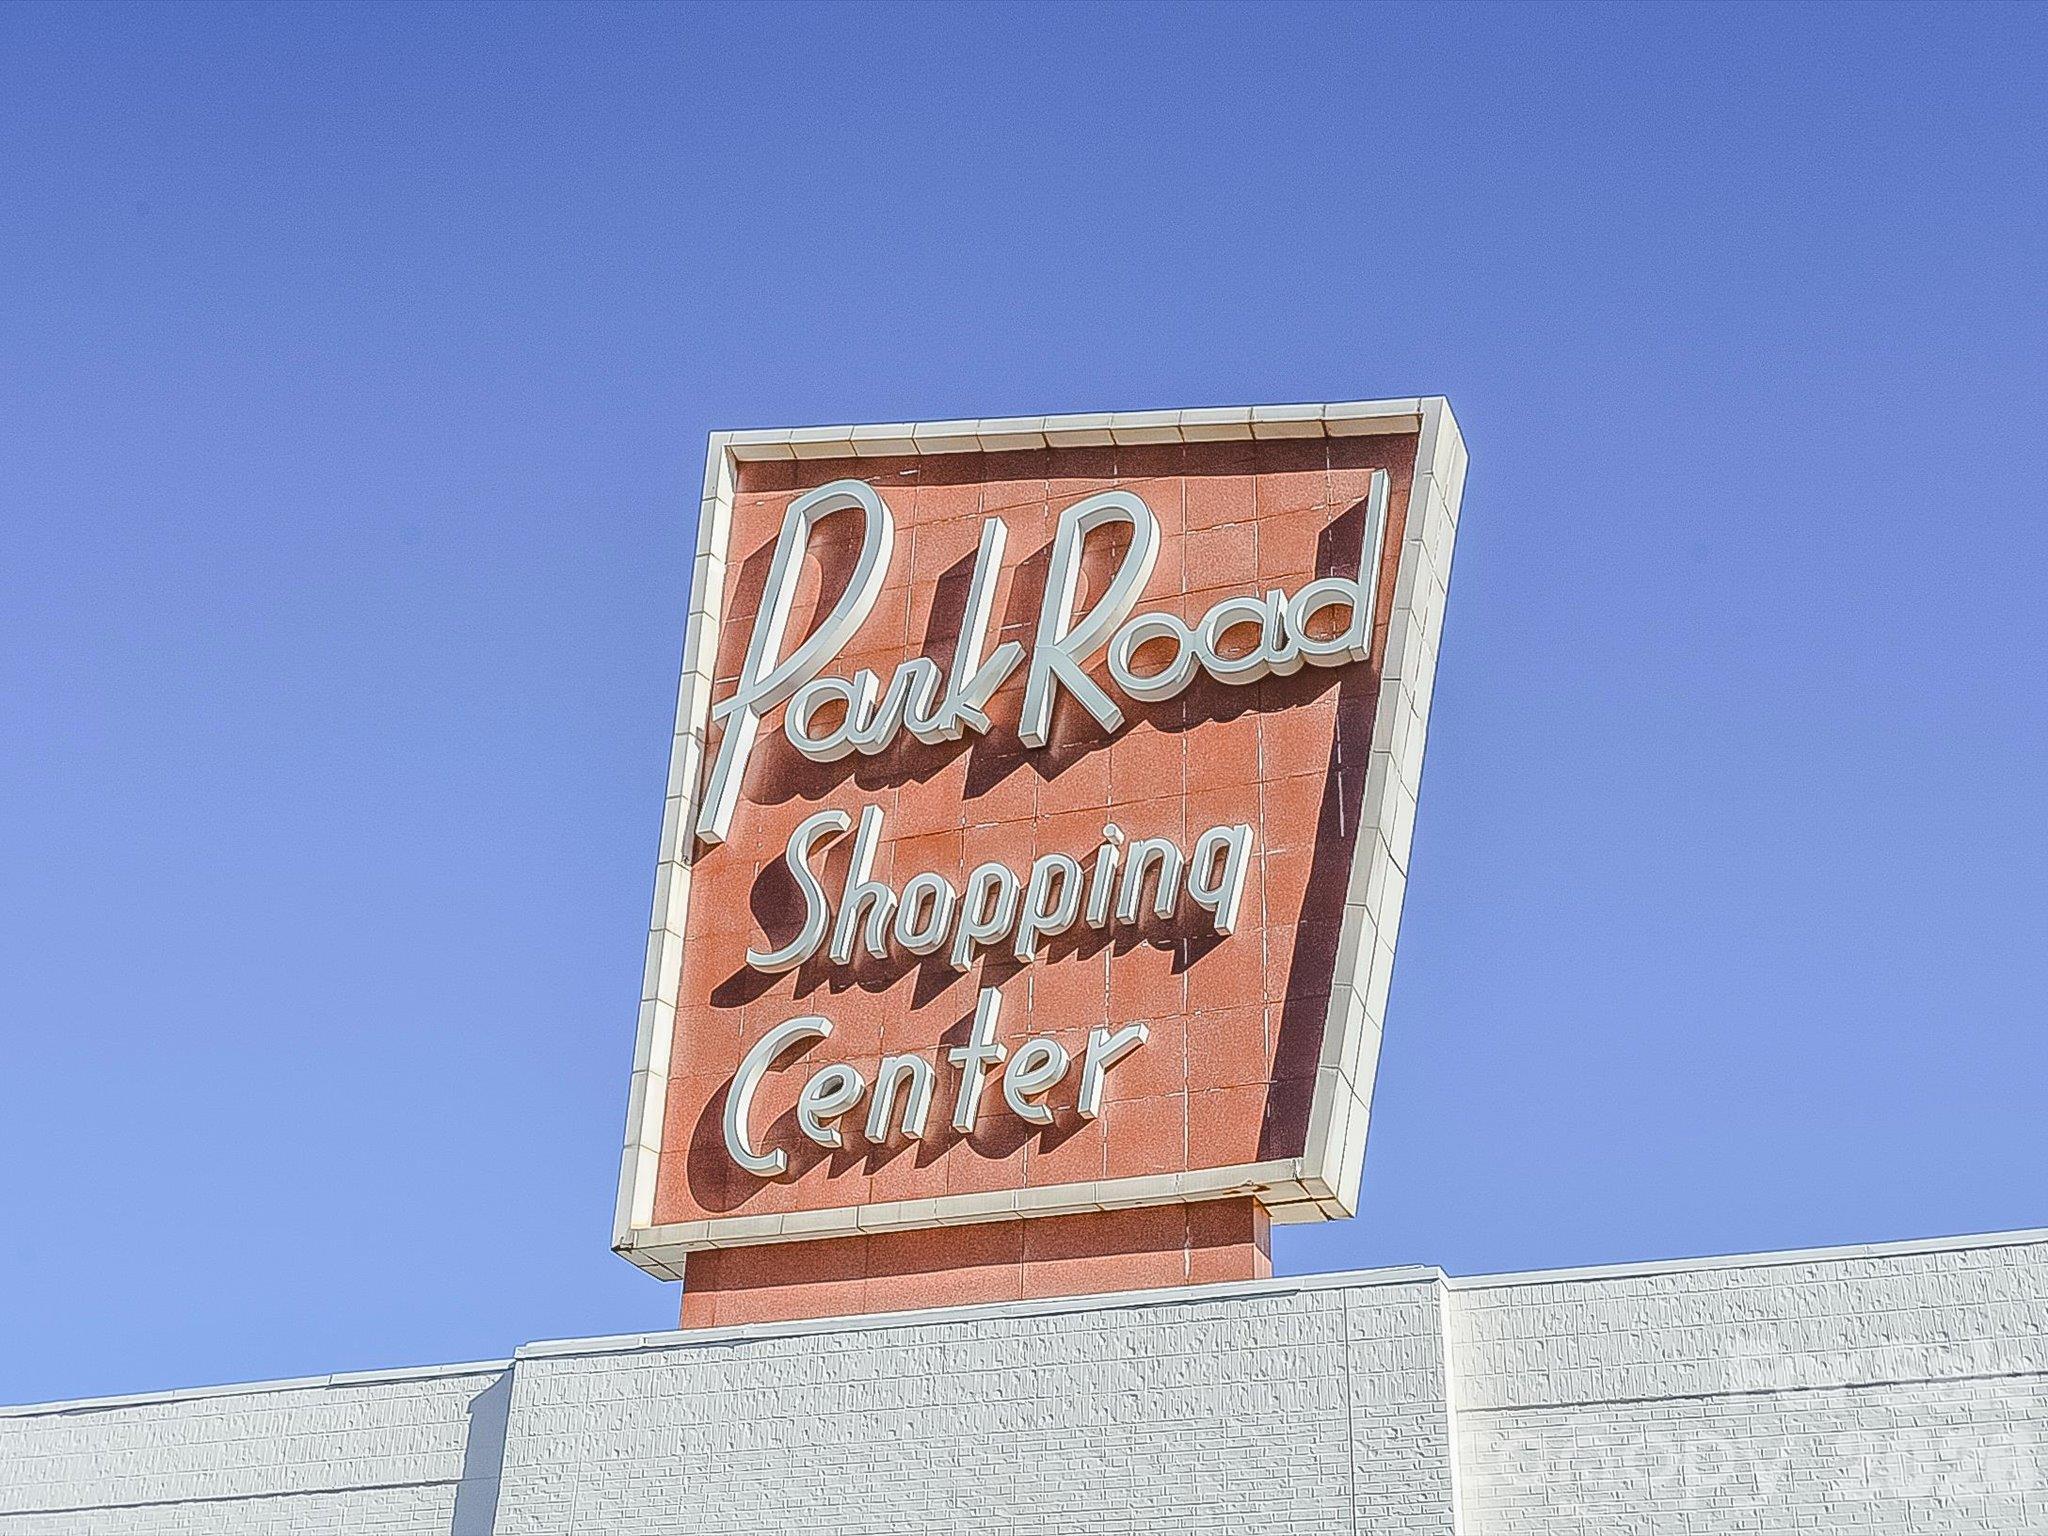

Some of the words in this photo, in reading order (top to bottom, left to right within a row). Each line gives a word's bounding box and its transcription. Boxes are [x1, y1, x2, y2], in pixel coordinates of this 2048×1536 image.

[695, 479, 1026, 844] Park
[1018, 468, 1389, 749] Road
[746, 804, 1254, 973] Shopping
[722, 986, 1150, 1177] Center
